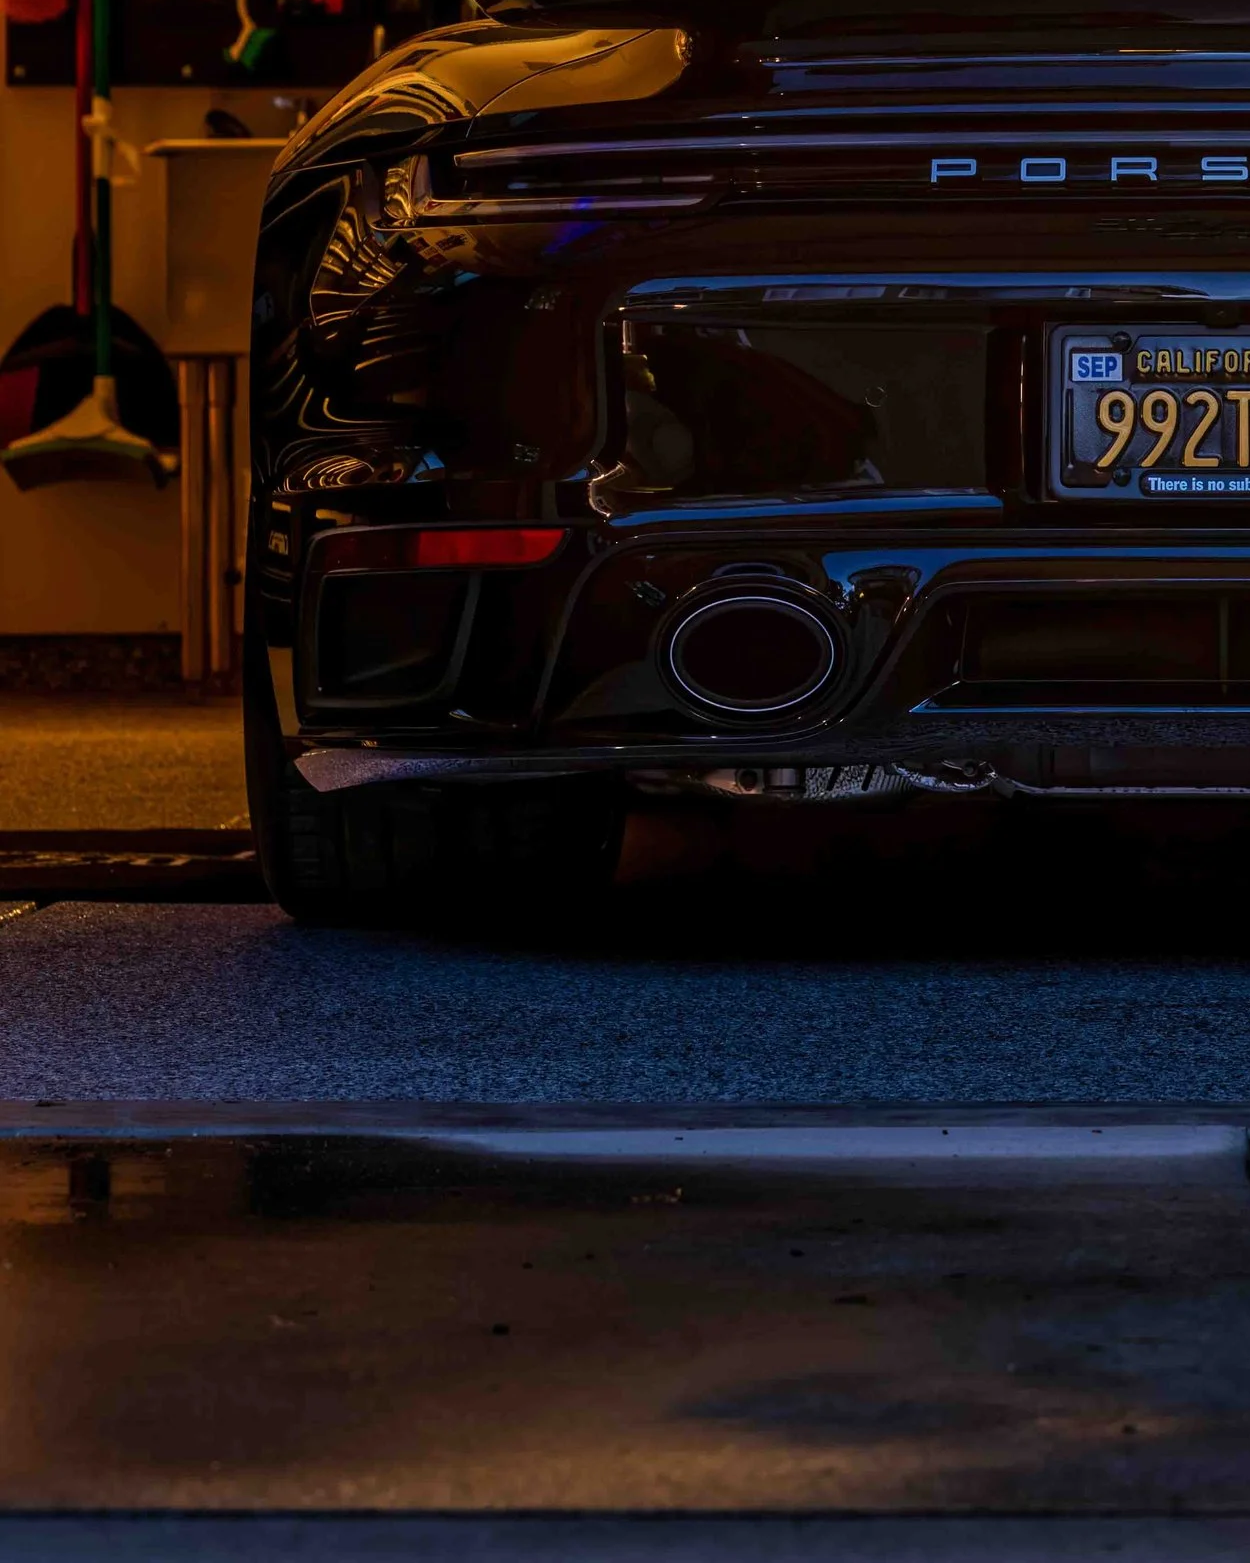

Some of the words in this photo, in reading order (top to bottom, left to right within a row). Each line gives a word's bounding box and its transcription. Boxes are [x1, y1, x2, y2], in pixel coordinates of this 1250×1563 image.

[1077, 355, 1118, 378] SEP
[1148, 476, 1188, 493] There
[1191, 476, 1204, 493] is
[1208, 480, 1226, 493] no
